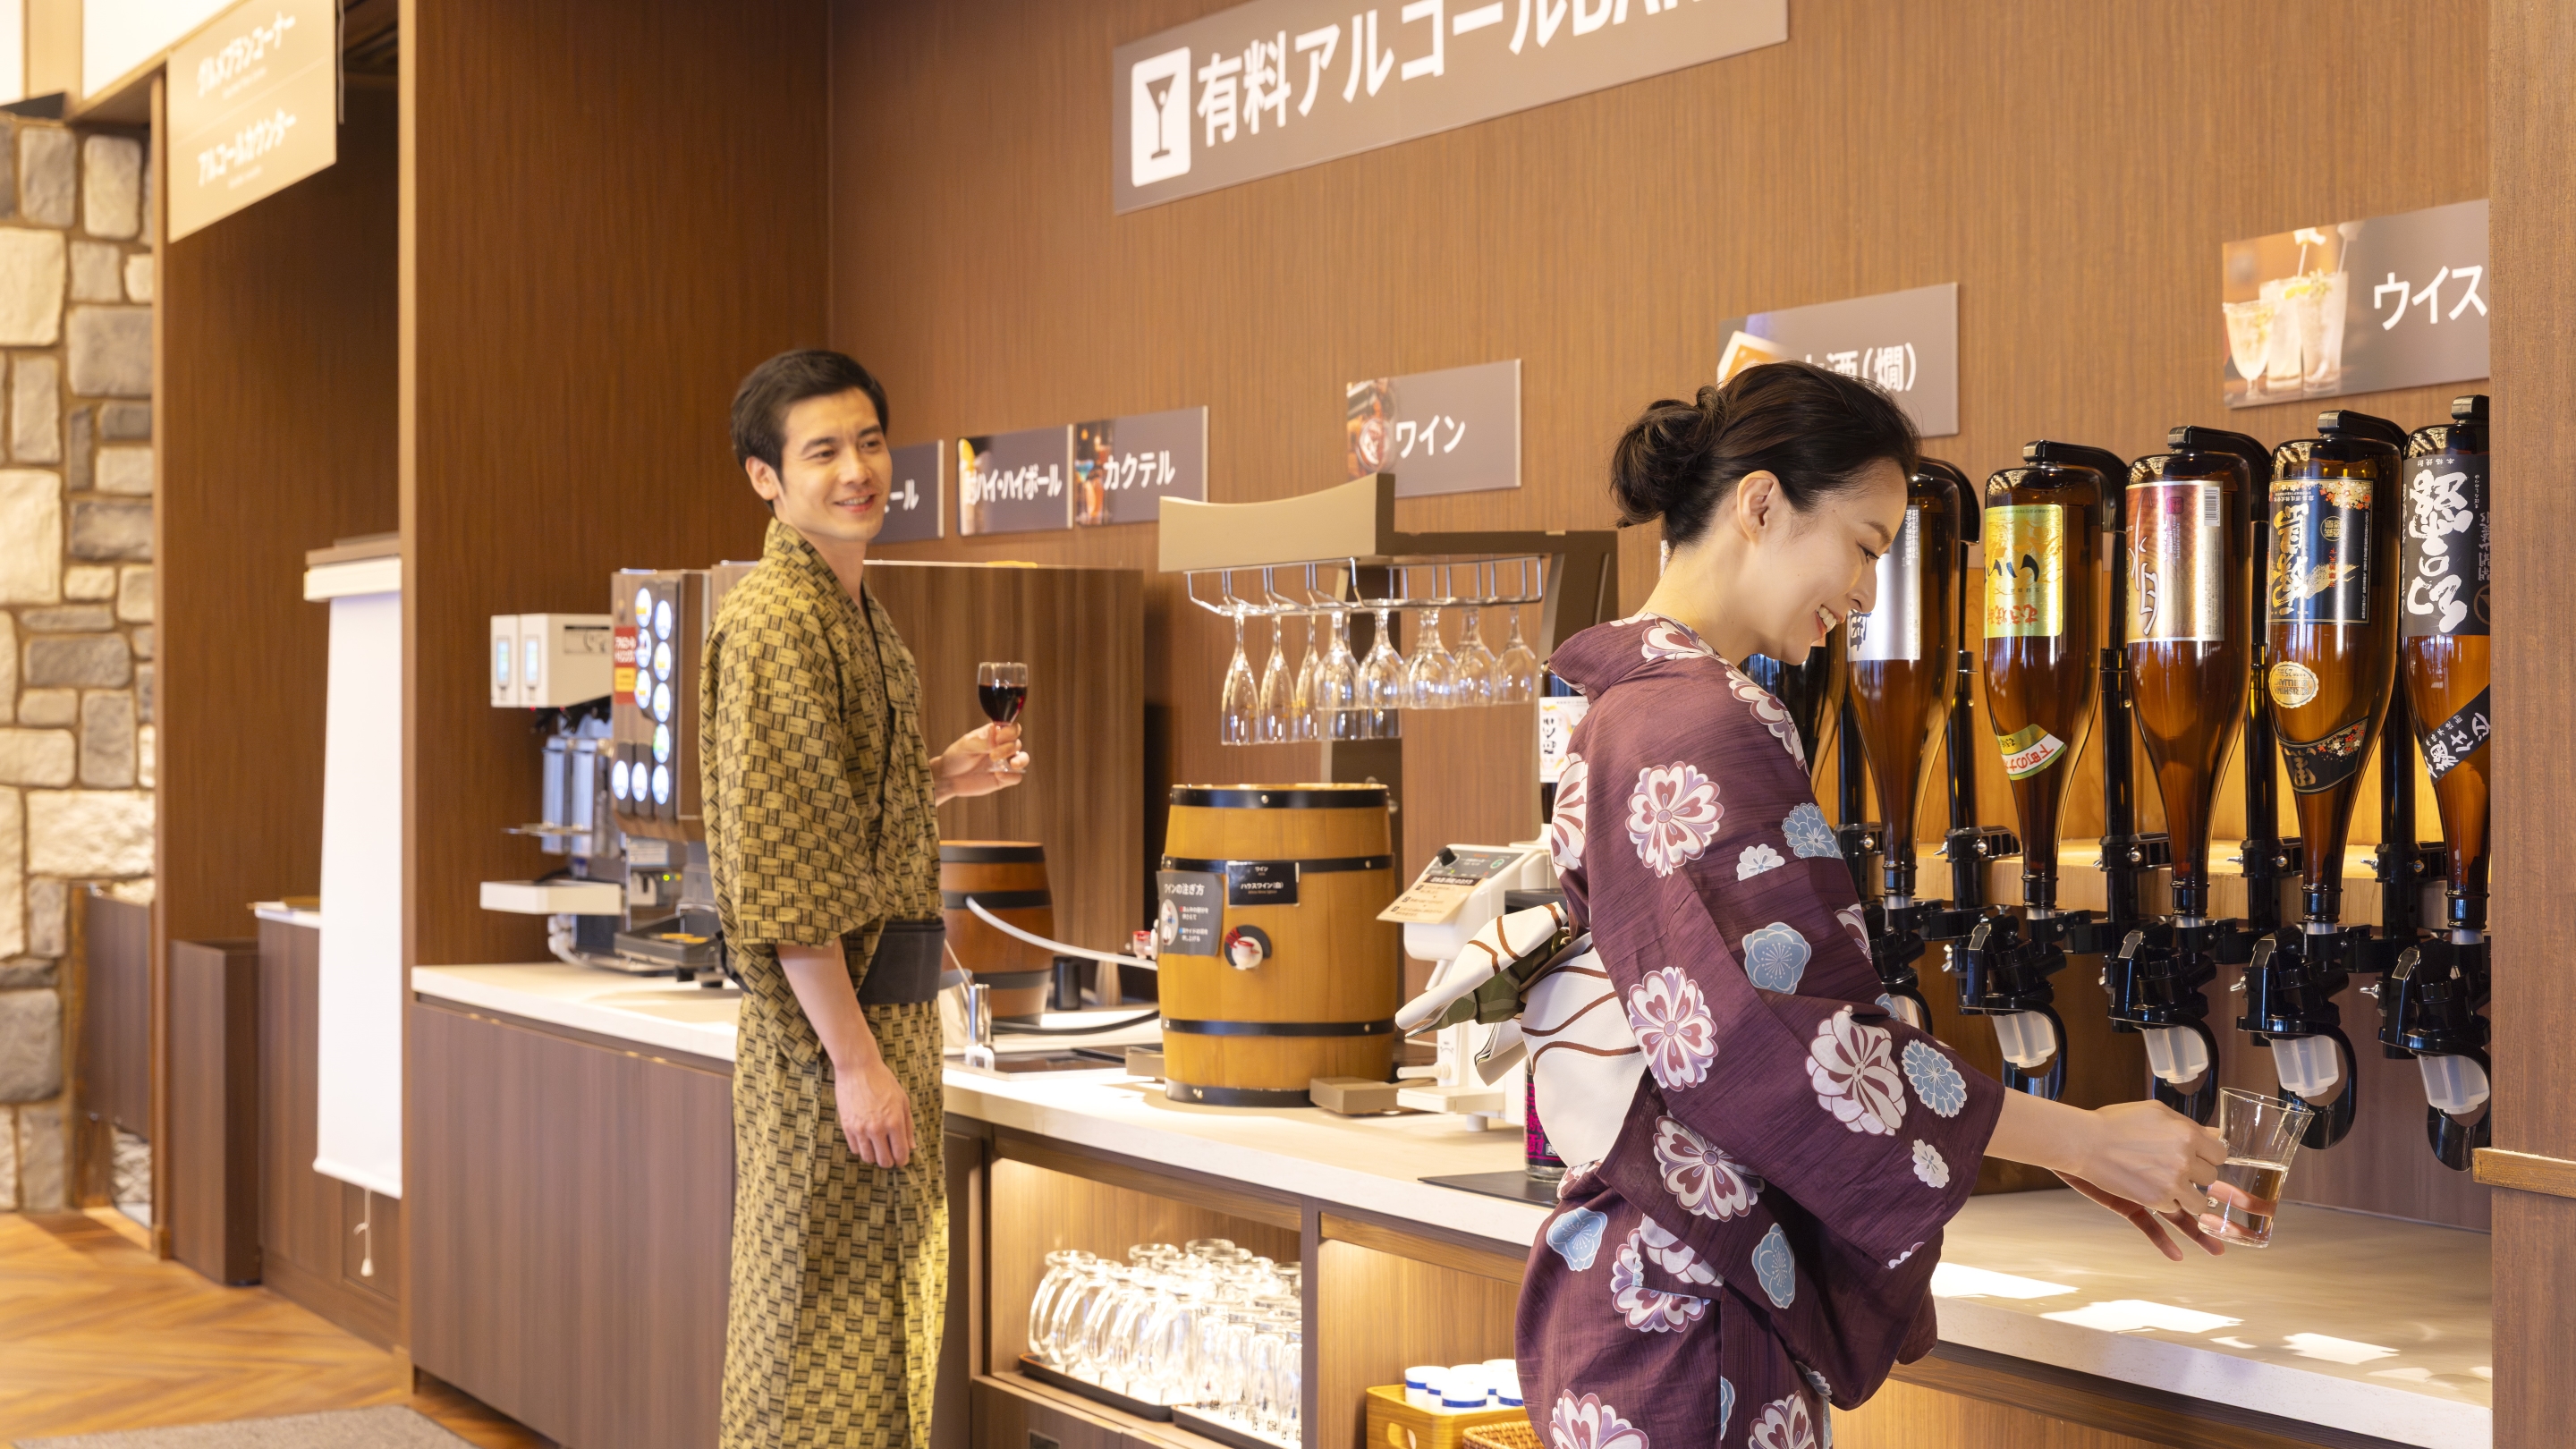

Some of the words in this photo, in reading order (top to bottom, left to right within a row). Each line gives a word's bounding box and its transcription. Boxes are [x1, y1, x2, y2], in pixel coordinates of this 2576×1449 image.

[1197, 0, 1701, 148] 有料アルコール
[2374, 265, 2488, 331] ウイス
[1395, 414, 1466, 459] ワイン
[1103, 450, 1175, 491] カクテル
[2417, 458, 2454, 467] 本格焼酎
[884, 479, 919, 514] ール
[2407, 469, 2473, 633] 幻の露
